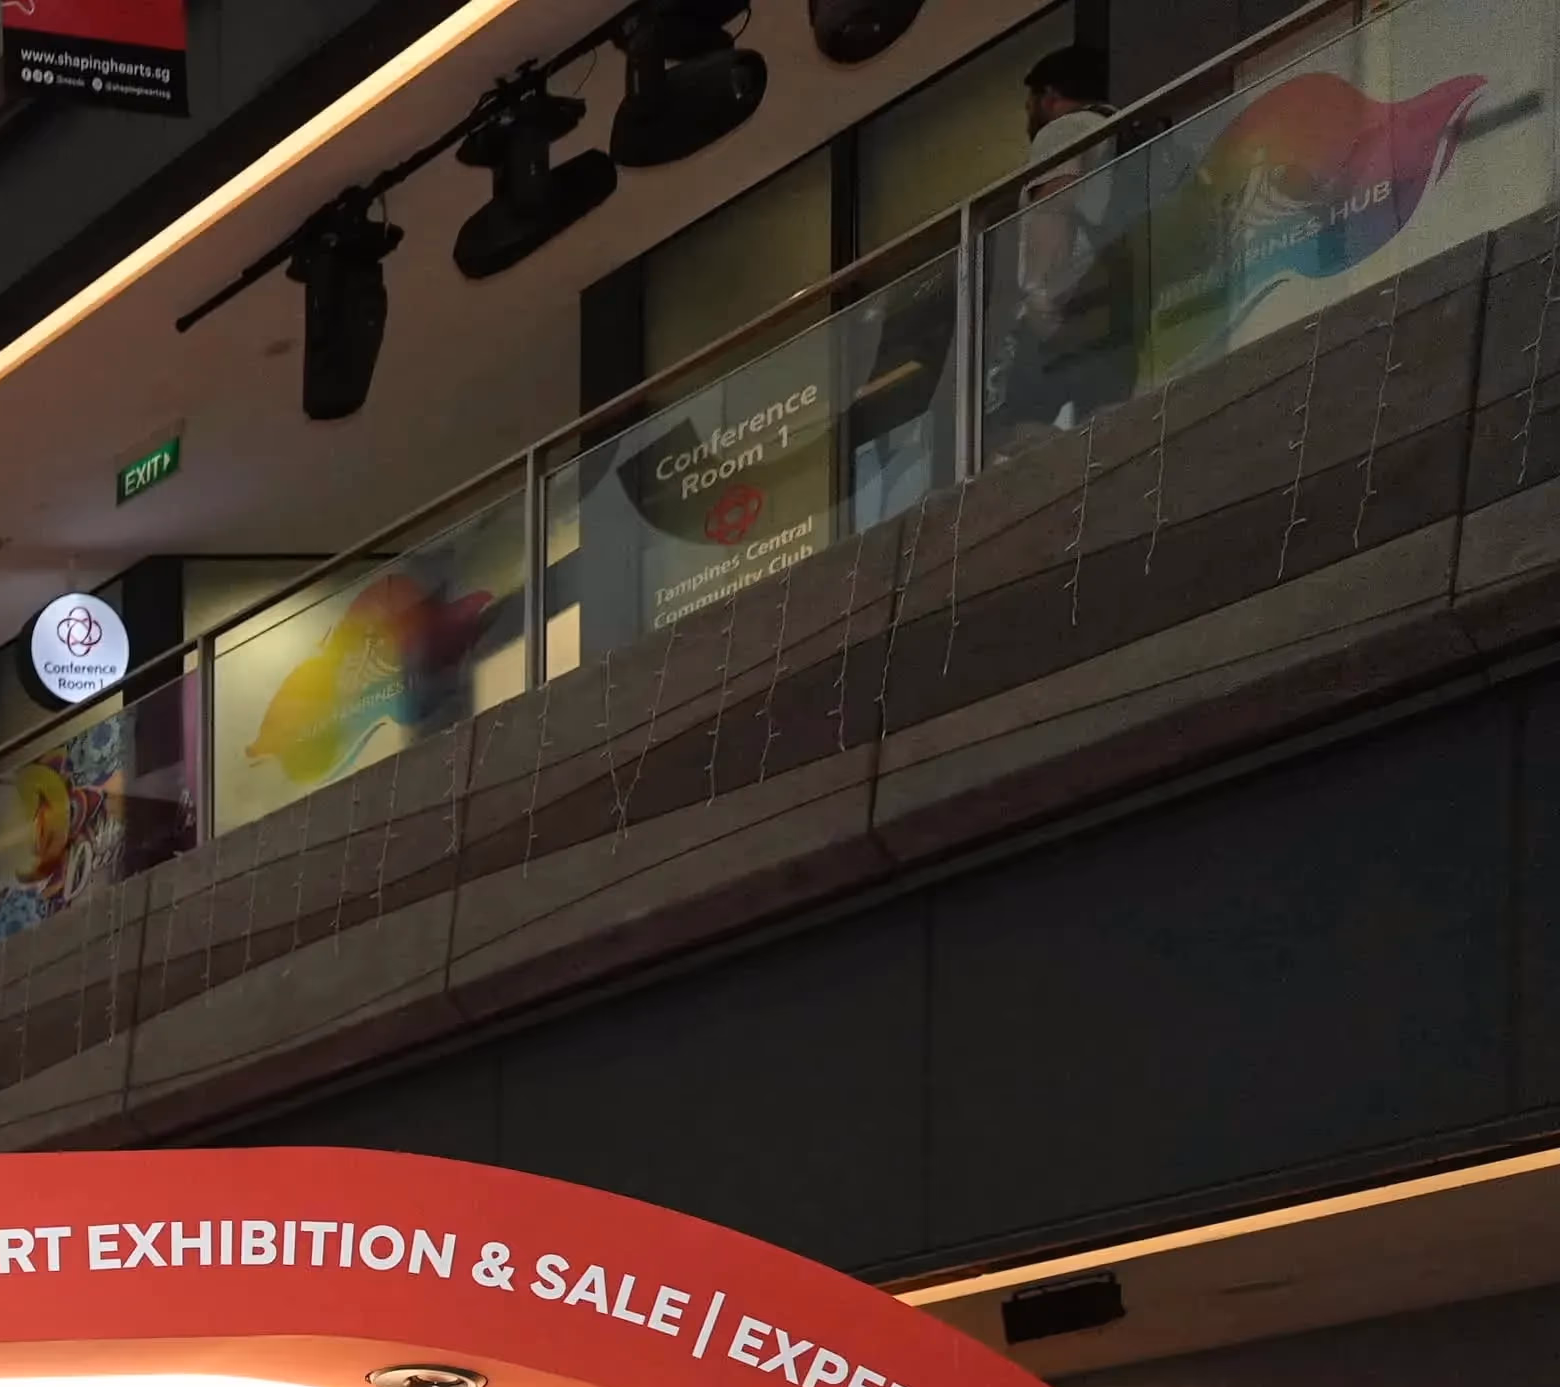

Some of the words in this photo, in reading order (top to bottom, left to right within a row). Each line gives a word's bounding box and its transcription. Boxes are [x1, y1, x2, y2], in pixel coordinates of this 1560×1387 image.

[21, 48, 171, 84] www.shapinghearts.sg
[655, 384, 819, 481] Conference
[681, 444, 764, 500] Room
[778, 424, 790, 449] 1
[124, 455, 161, 497] EXIT
[653, 567, 763, 630] Community
[768, 543, 814, 575] Club
[654, 552, 741, 606] Tampines
[745, 515, 813, 561] Central
[43, 661, 118, 677] Conference
[57, 678, 96, 691] Room
[86, 1218, 458, 1280] EXHIBITION
[470, 1241, 516, 1292] &
[528, 1252, 692, 1339] SALE
